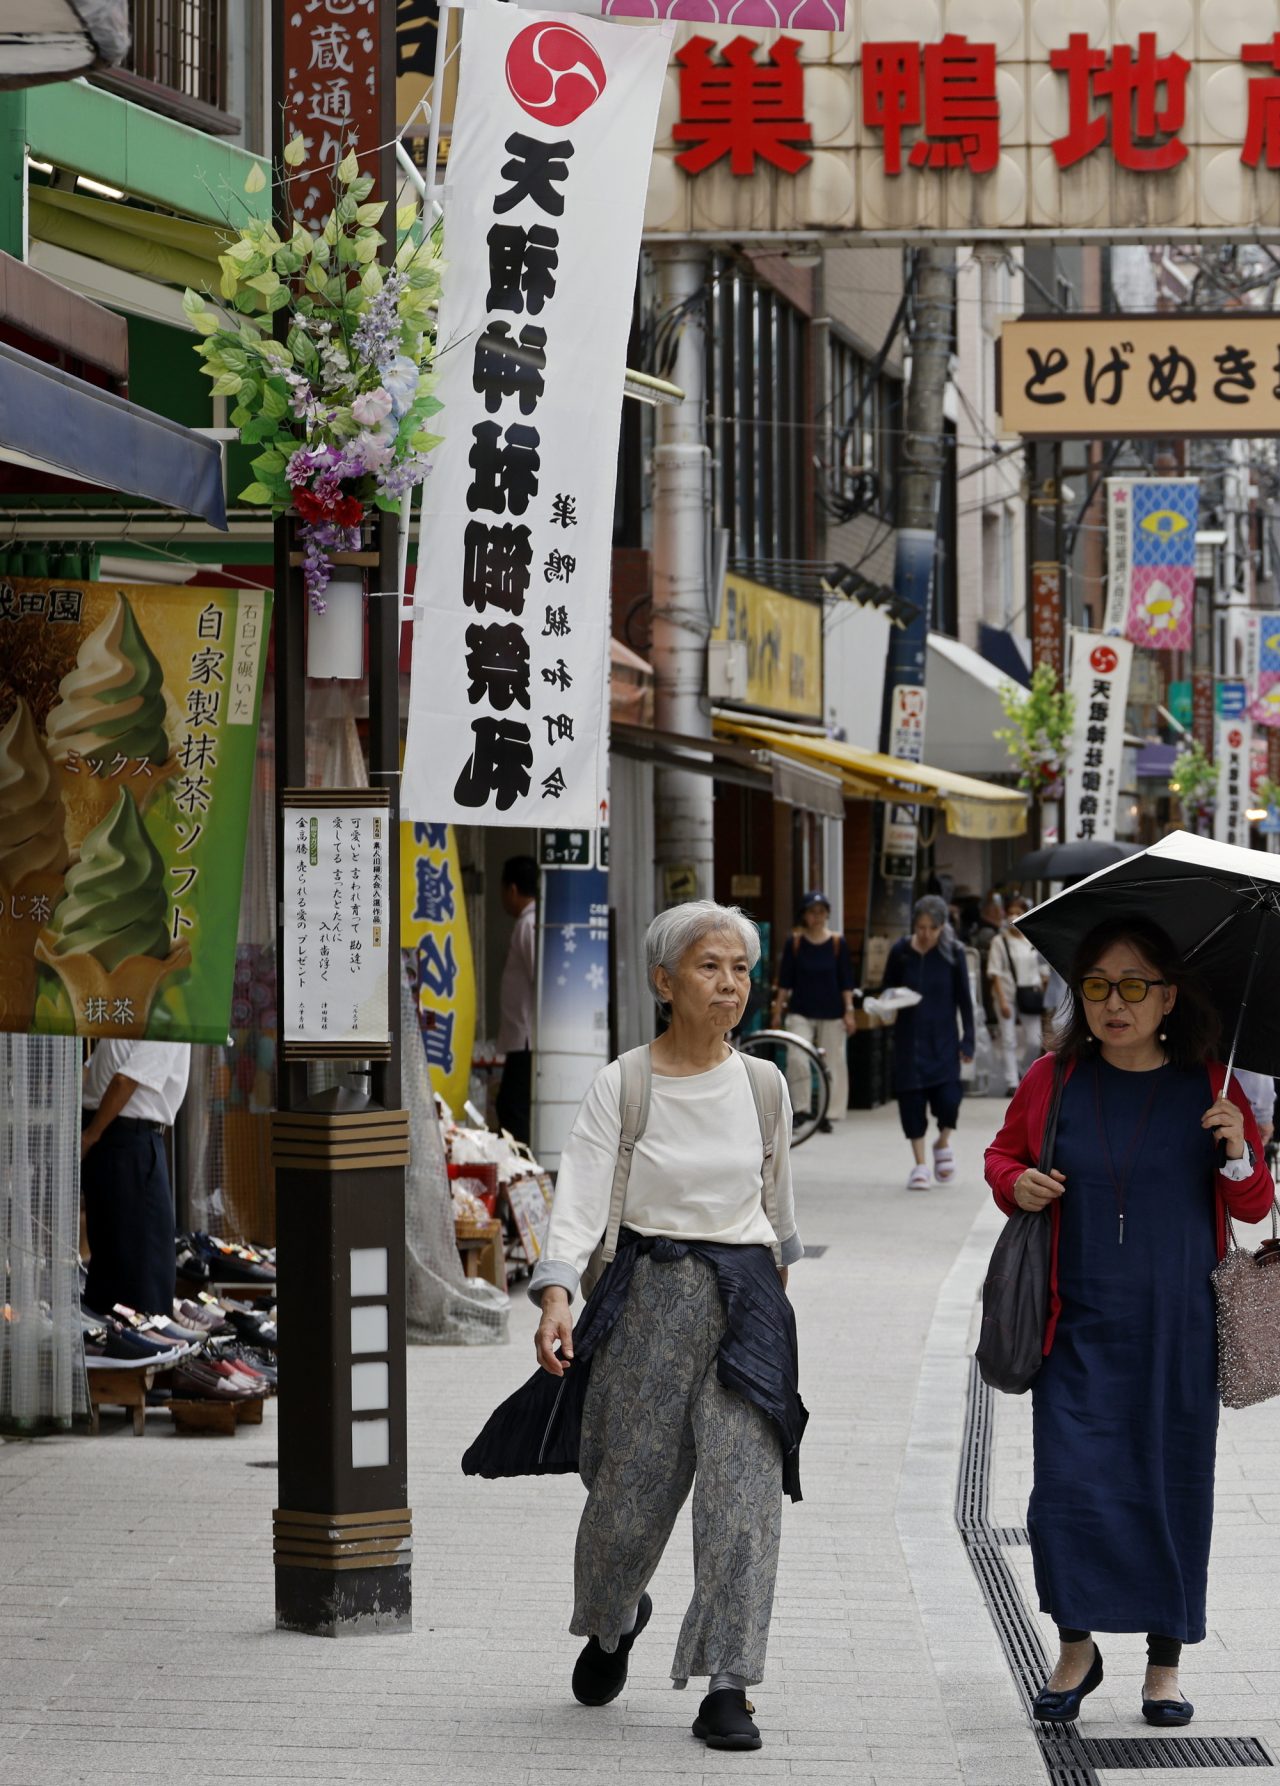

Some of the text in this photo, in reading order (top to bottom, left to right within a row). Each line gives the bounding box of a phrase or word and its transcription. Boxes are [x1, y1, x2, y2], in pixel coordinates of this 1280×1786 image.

[304, 0, 356, 180] 蔵通り
[64, 750, 153, 777] ミックス
[170, 602, 225, 938] 自家製抹茶ソフト
[332, 817, 343, 863] 愛してる
[350, 818, 361, 862] 可愛いと
[546, 849, 580, 862] 3-17
[297, 935, 308, 988] プレゼント
[84, 997, 135, 1026] 抹茶
